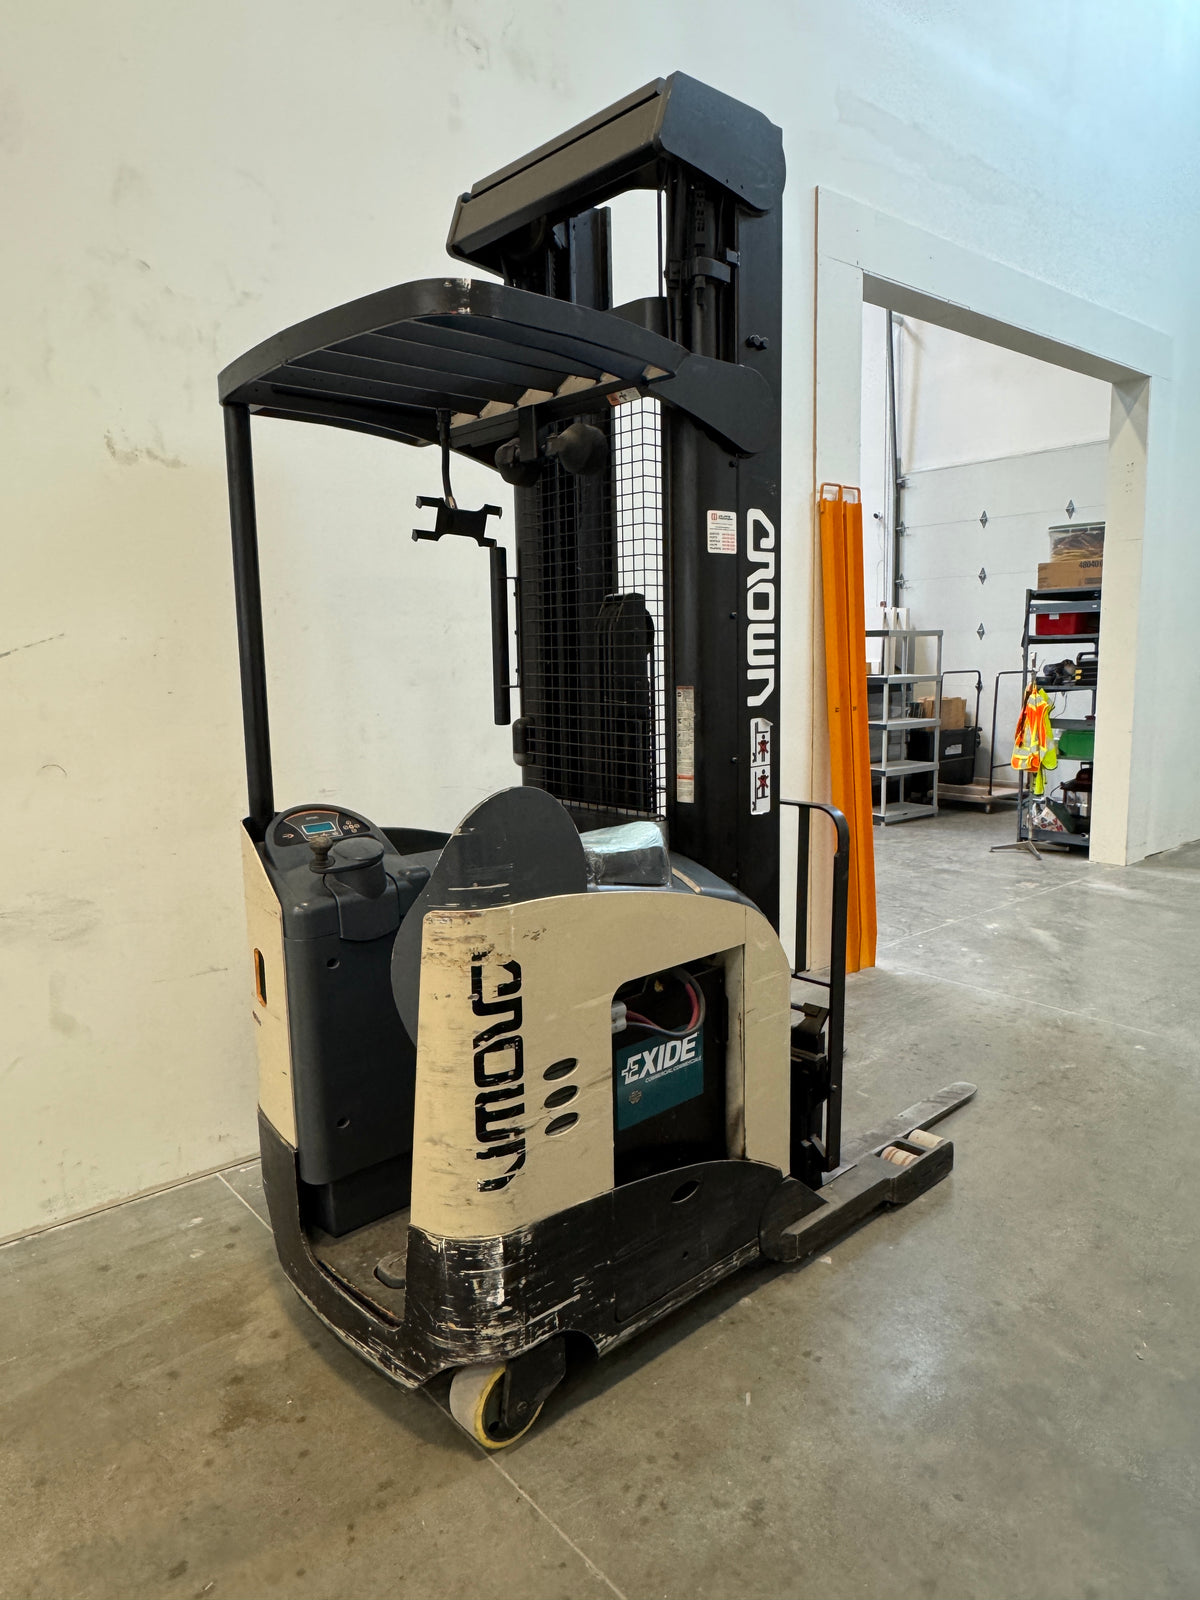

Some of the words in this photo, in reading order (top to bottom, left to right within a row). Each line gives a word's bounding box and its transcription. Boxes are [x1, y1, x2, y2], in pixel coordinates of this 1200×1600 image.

[747, 508, 775, 707] CROWN
[470, 944, 526, 1193] CROWN
[621, 1032, 698, 1085] EXIDE
